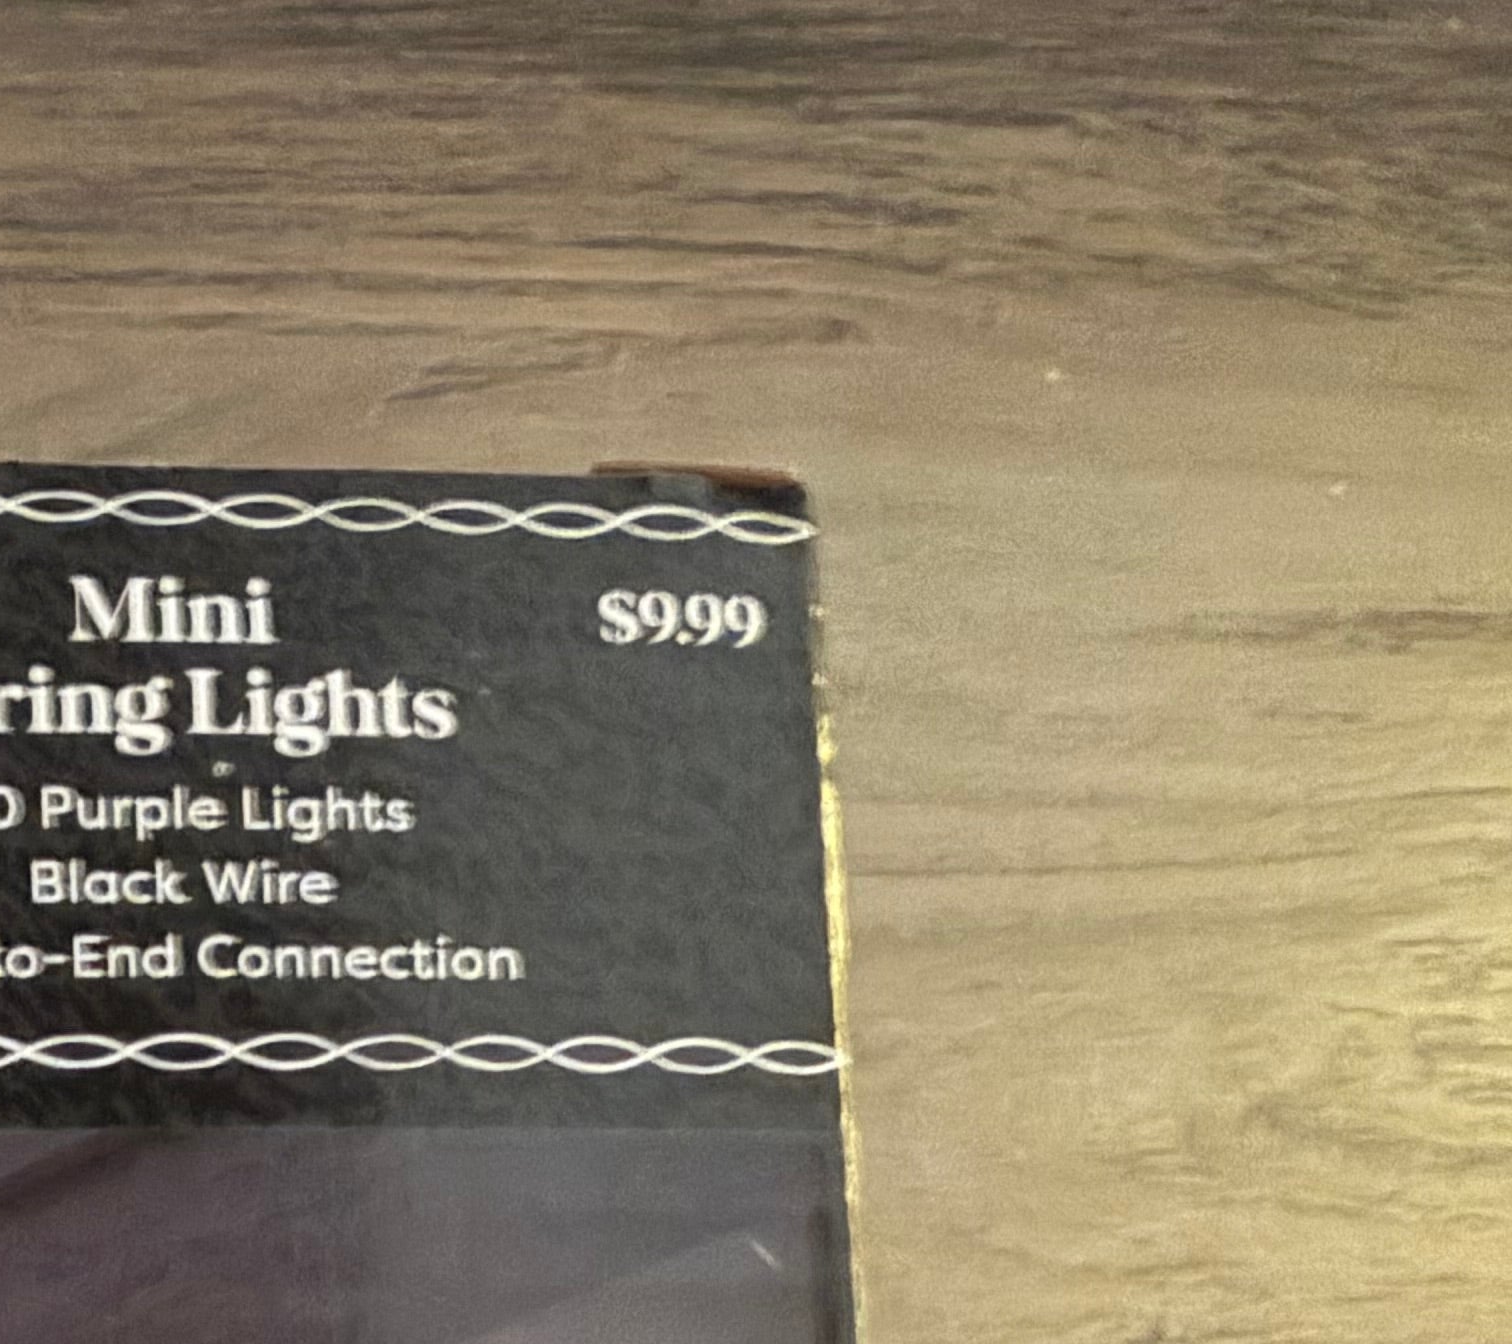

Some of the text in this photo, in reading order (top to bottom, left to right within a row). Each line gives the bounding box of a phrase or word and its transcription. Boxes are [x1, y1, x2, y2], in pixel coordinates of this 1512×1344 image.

[67, 575, 281, 646] Mini
[597, 588, 769, 648] $9.99
[187, 667, 458, 759] Lights
[39, 785, 228, 841] Purple
[242, 787, 416, 842] Lights
[29, 859, 340, 906] Black Wire
[198, 934, 526, 982] Connection
